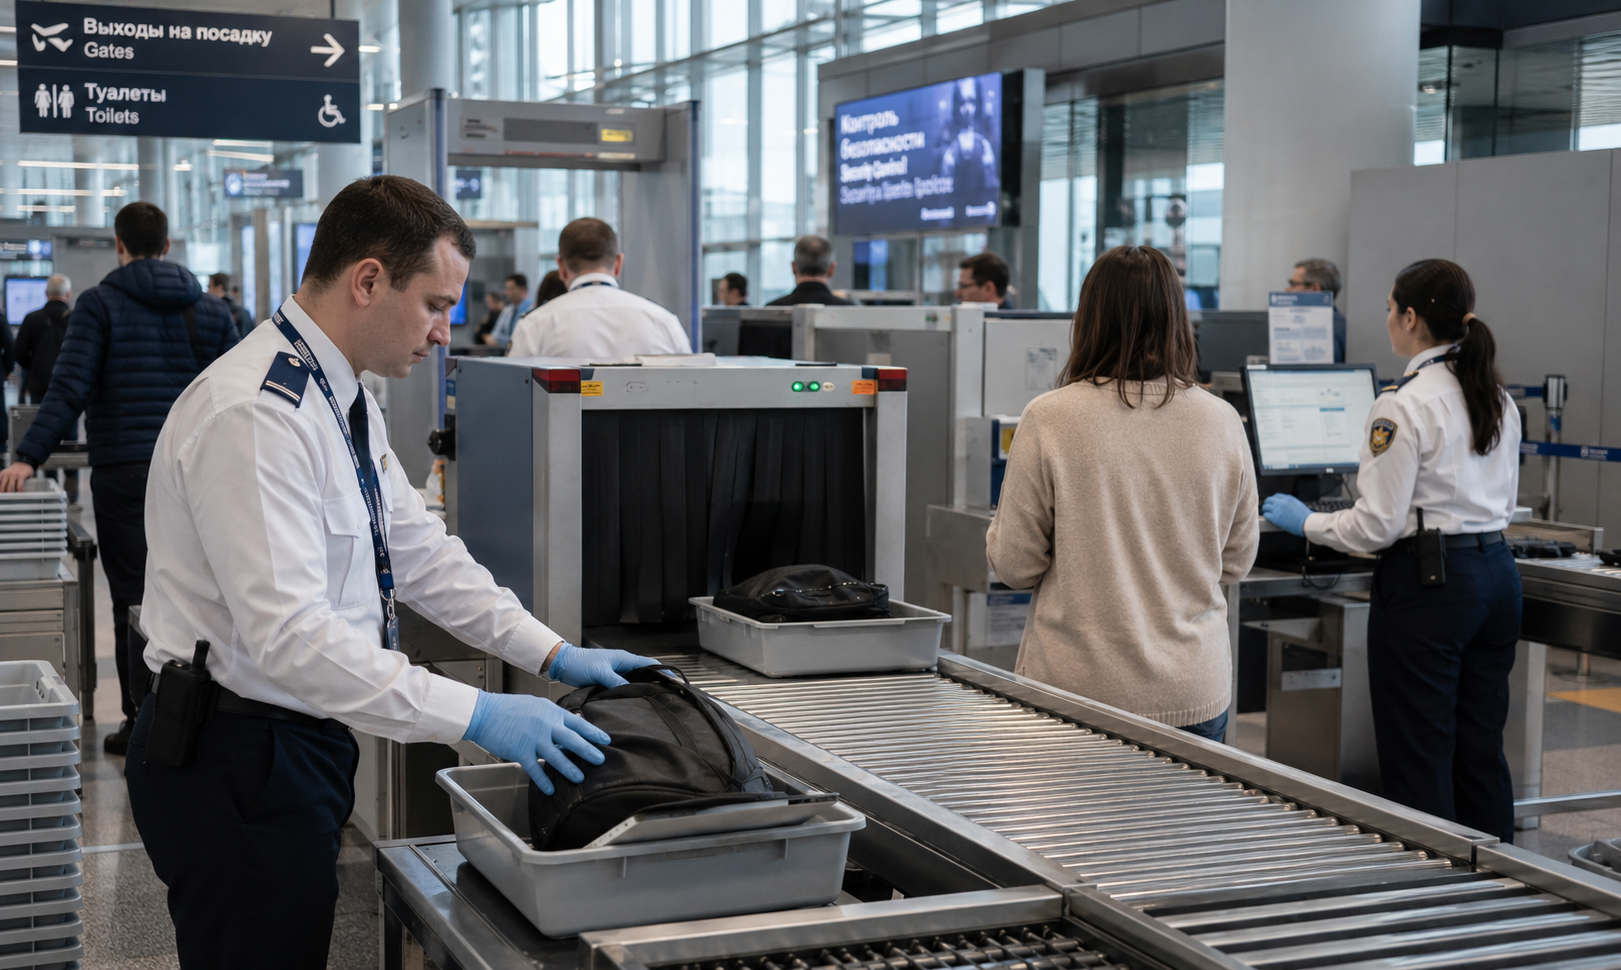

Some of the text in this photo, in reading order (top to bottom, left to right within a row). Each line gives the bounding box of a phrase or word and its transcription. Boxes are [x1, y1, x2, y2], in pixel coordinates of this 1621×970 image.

[83, 17, 273, 48] Выходы на посадку
[83, 41, 135, 60] Gates
[84, 82, 167, 103] Туалеты
[85, 106, 140, 125] Toilets
